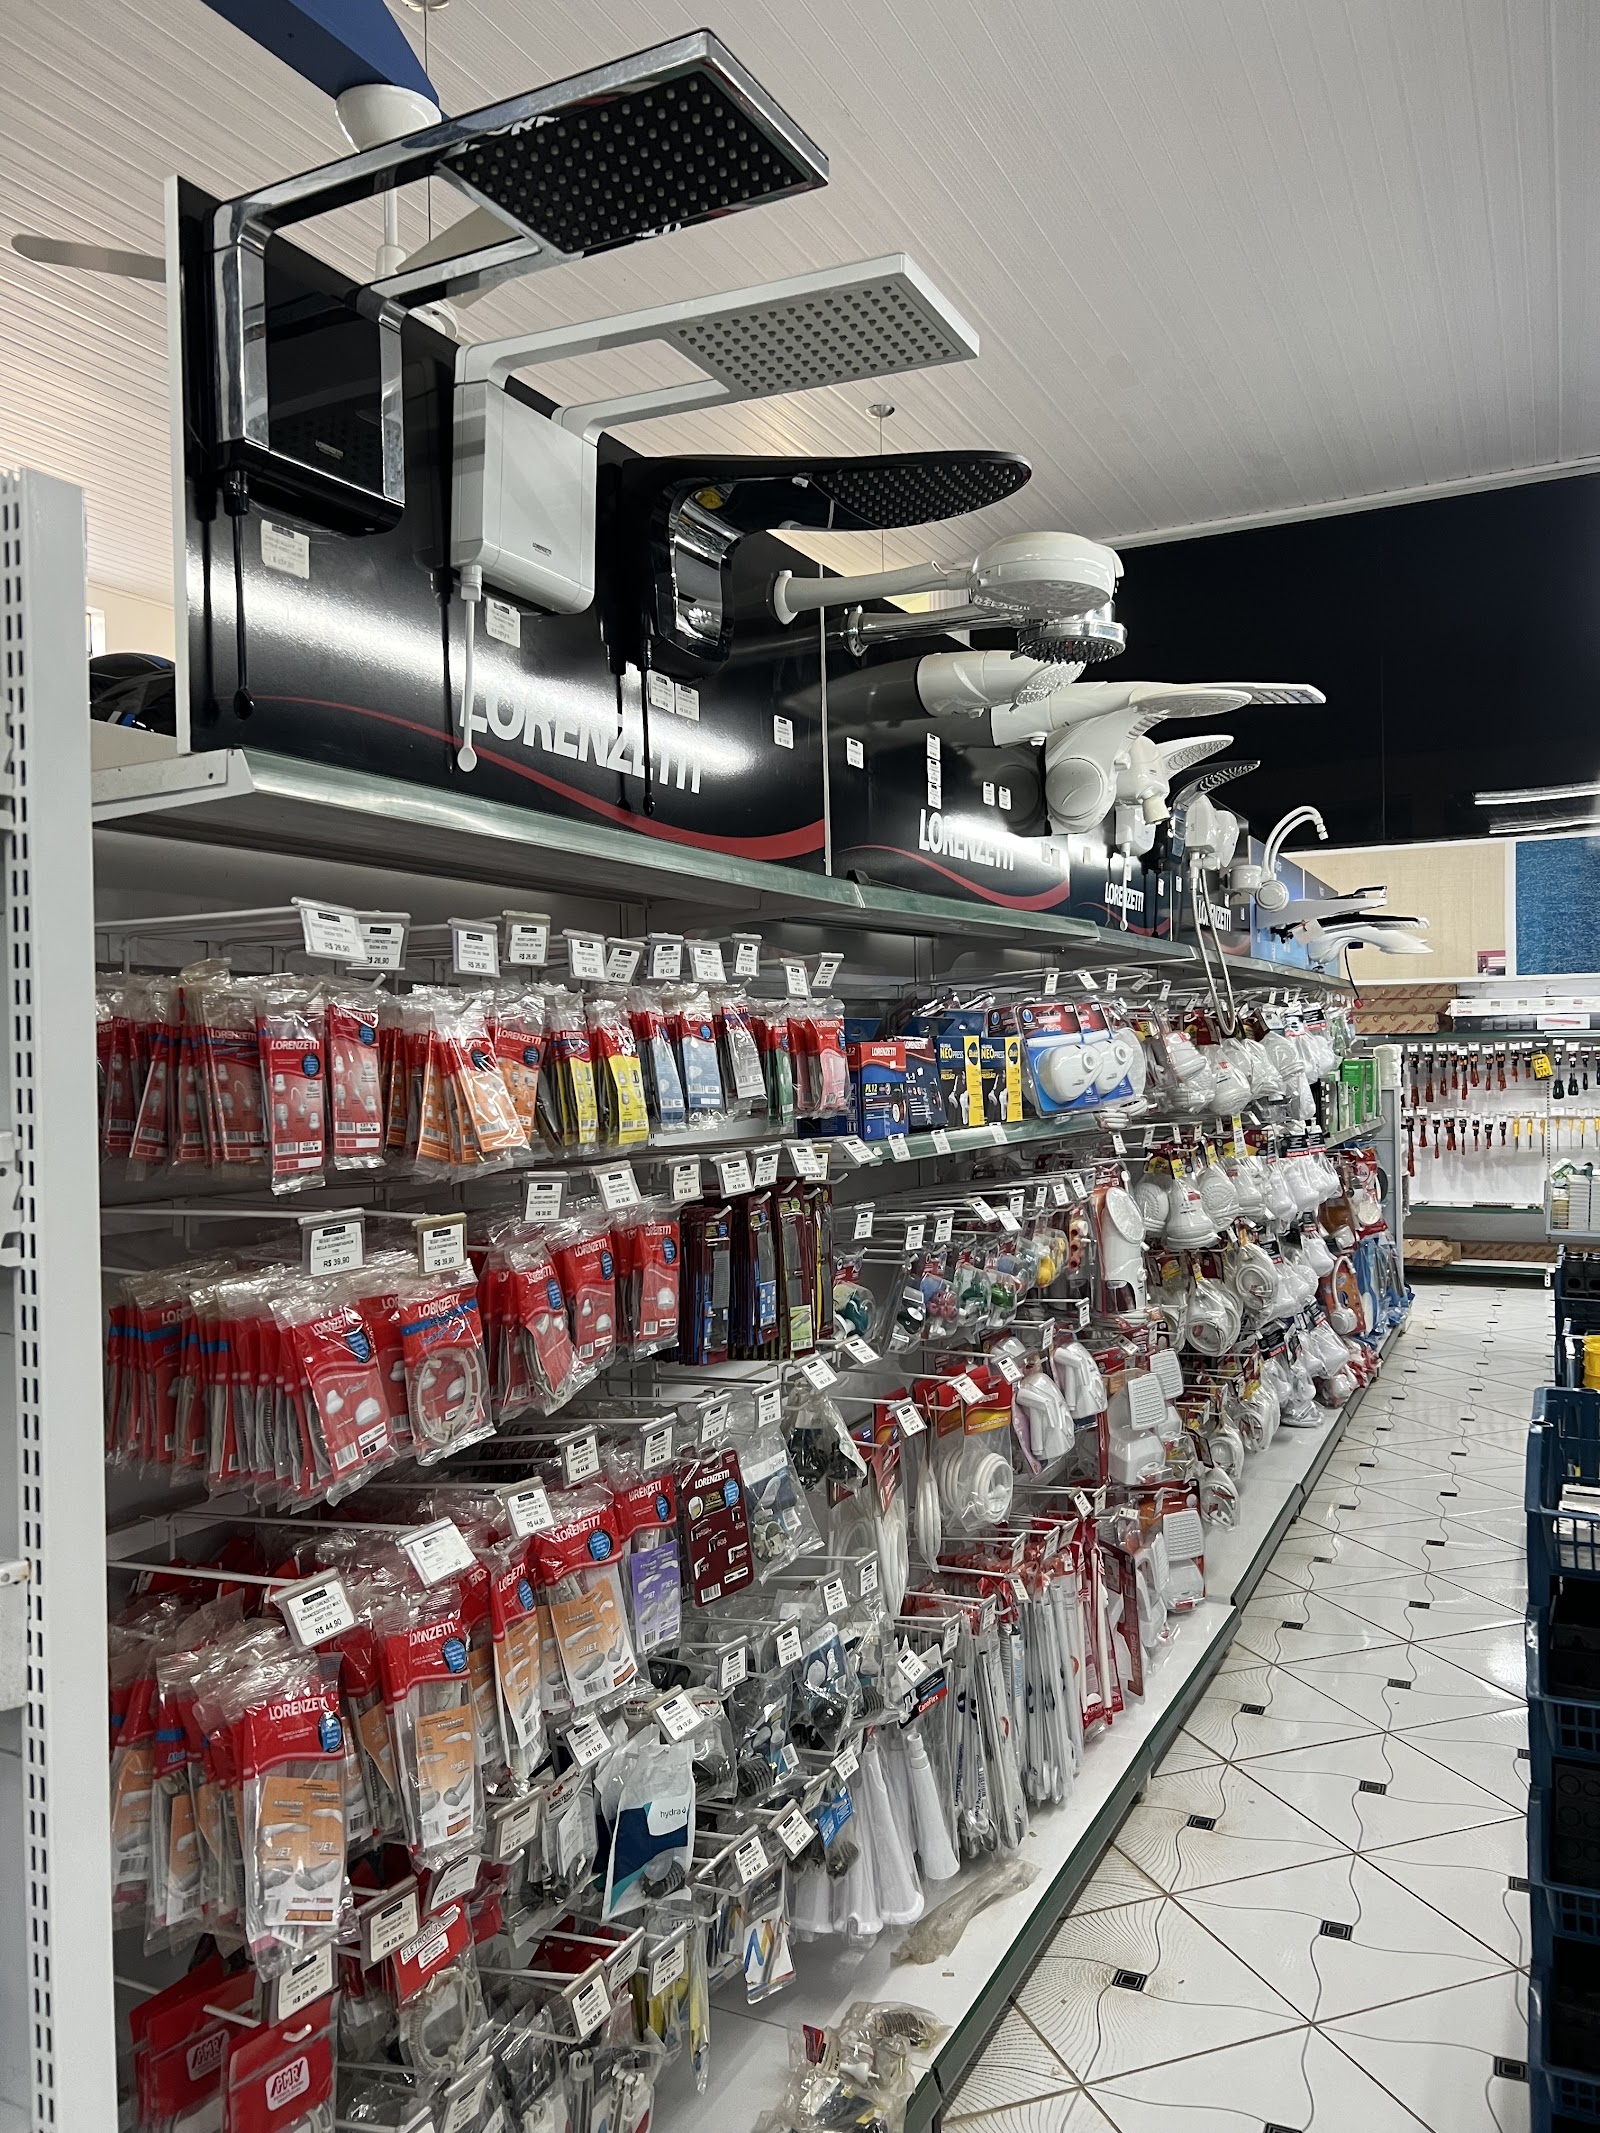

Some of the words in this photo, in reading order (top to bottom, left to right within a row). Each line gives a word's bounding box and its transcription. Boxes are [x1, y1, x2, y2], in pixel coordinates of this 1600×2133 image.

[459, 690, 700, 794] LORENZETTI
[919, 808, 1014, 871] LORENZETTI
[210, 1028, 257, 1041] LORENZETTI
[499, 1030, 542, 1046] LORENZETTI
[271, 1040, 320, 1051] LORENZETTI
[871, 1047, 897, 1058] LORENZETTI
[323, 1259, 332, 1268] R$
[333, 1256, 350, 1267] 39,90
[694, 1469, 730, 1490] LORENZETTI
[526, 1520, 533, 1529] R$
[314, 1625, 325, 1637] R$
[325, 1617, 342, 1631] 44,90
[660, 1808, 682, 1820] hydra
